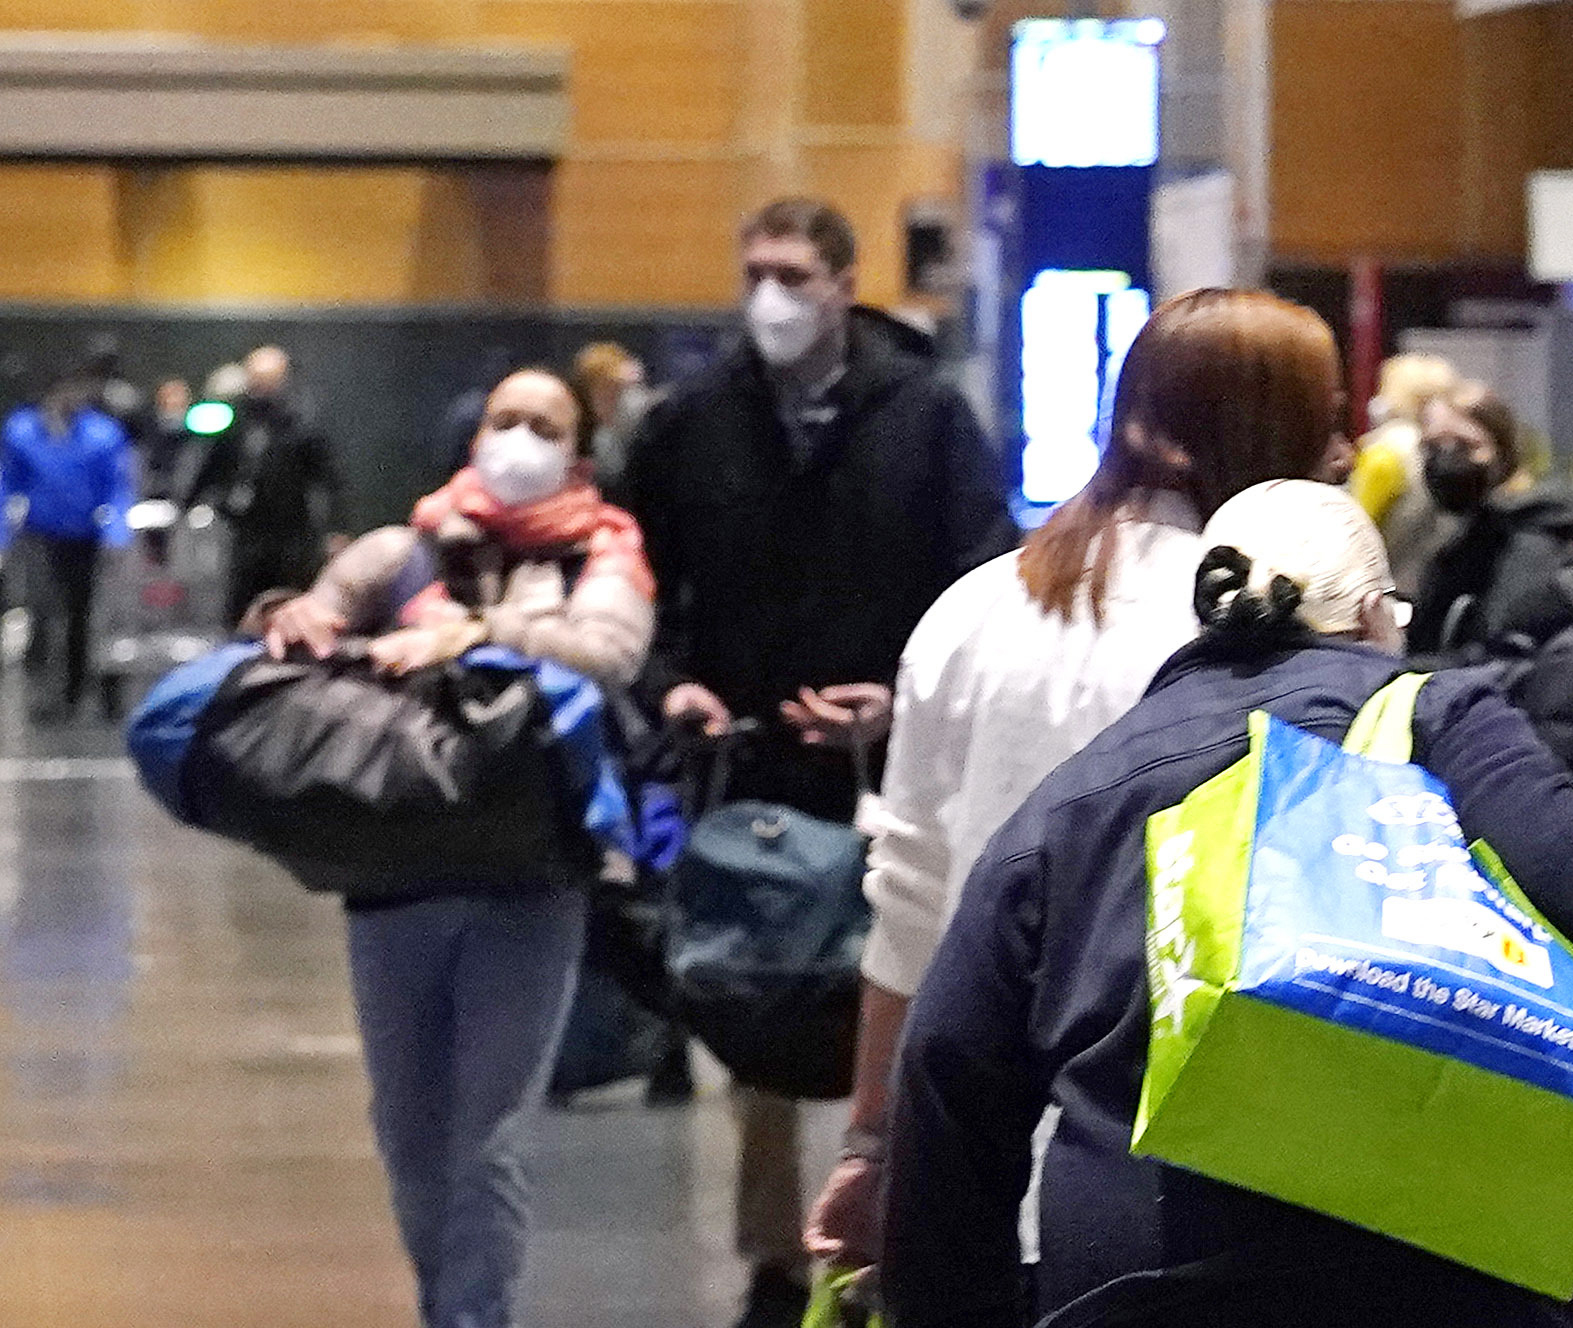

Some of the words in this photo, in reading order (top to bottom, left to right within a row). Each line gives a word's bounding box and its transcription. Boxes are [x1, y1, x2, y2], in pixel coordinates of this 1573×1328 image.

[1295, 948, 1412, 993] Download
[1412, 976, 1450, 1005] the
[1452, 987, 1500, 1020] Star
